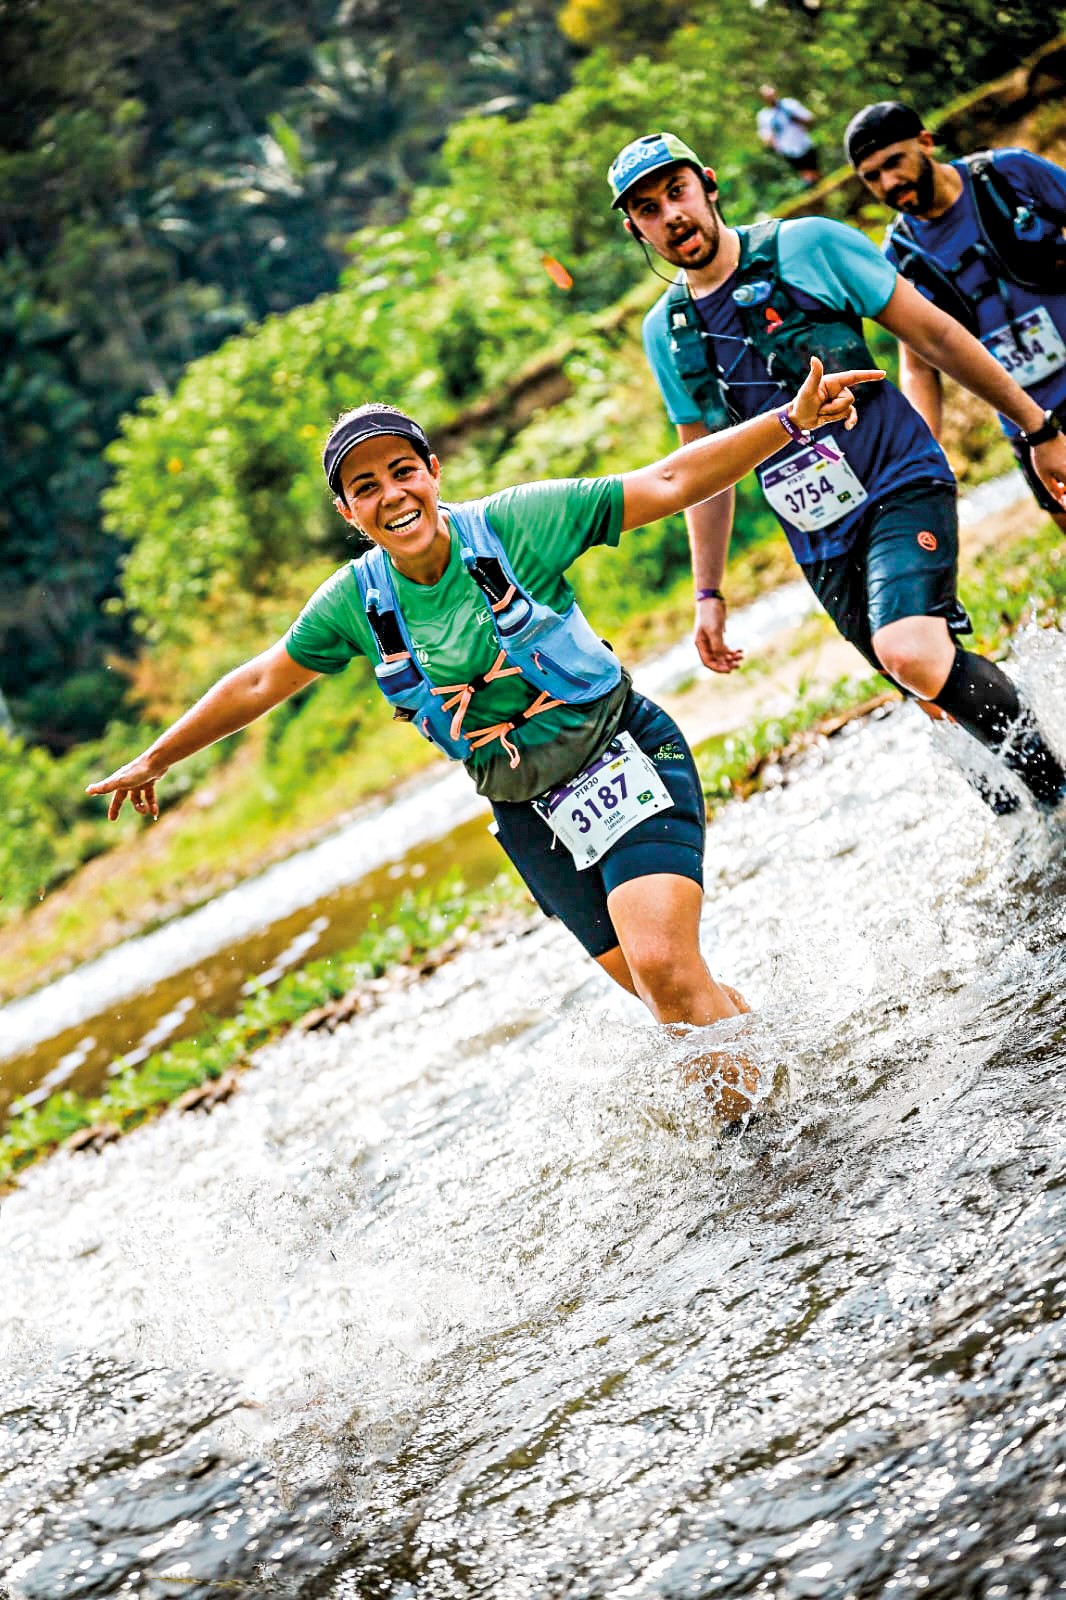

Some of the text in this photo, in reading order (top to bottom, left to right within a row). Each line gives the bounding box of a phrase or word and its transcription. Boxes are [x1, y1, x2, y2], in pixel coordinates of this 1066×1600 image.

[784, 475, 835, 514] 3754
[571, 773, 629, 834] 3187
[574, 776, 599, 799] PTR20
